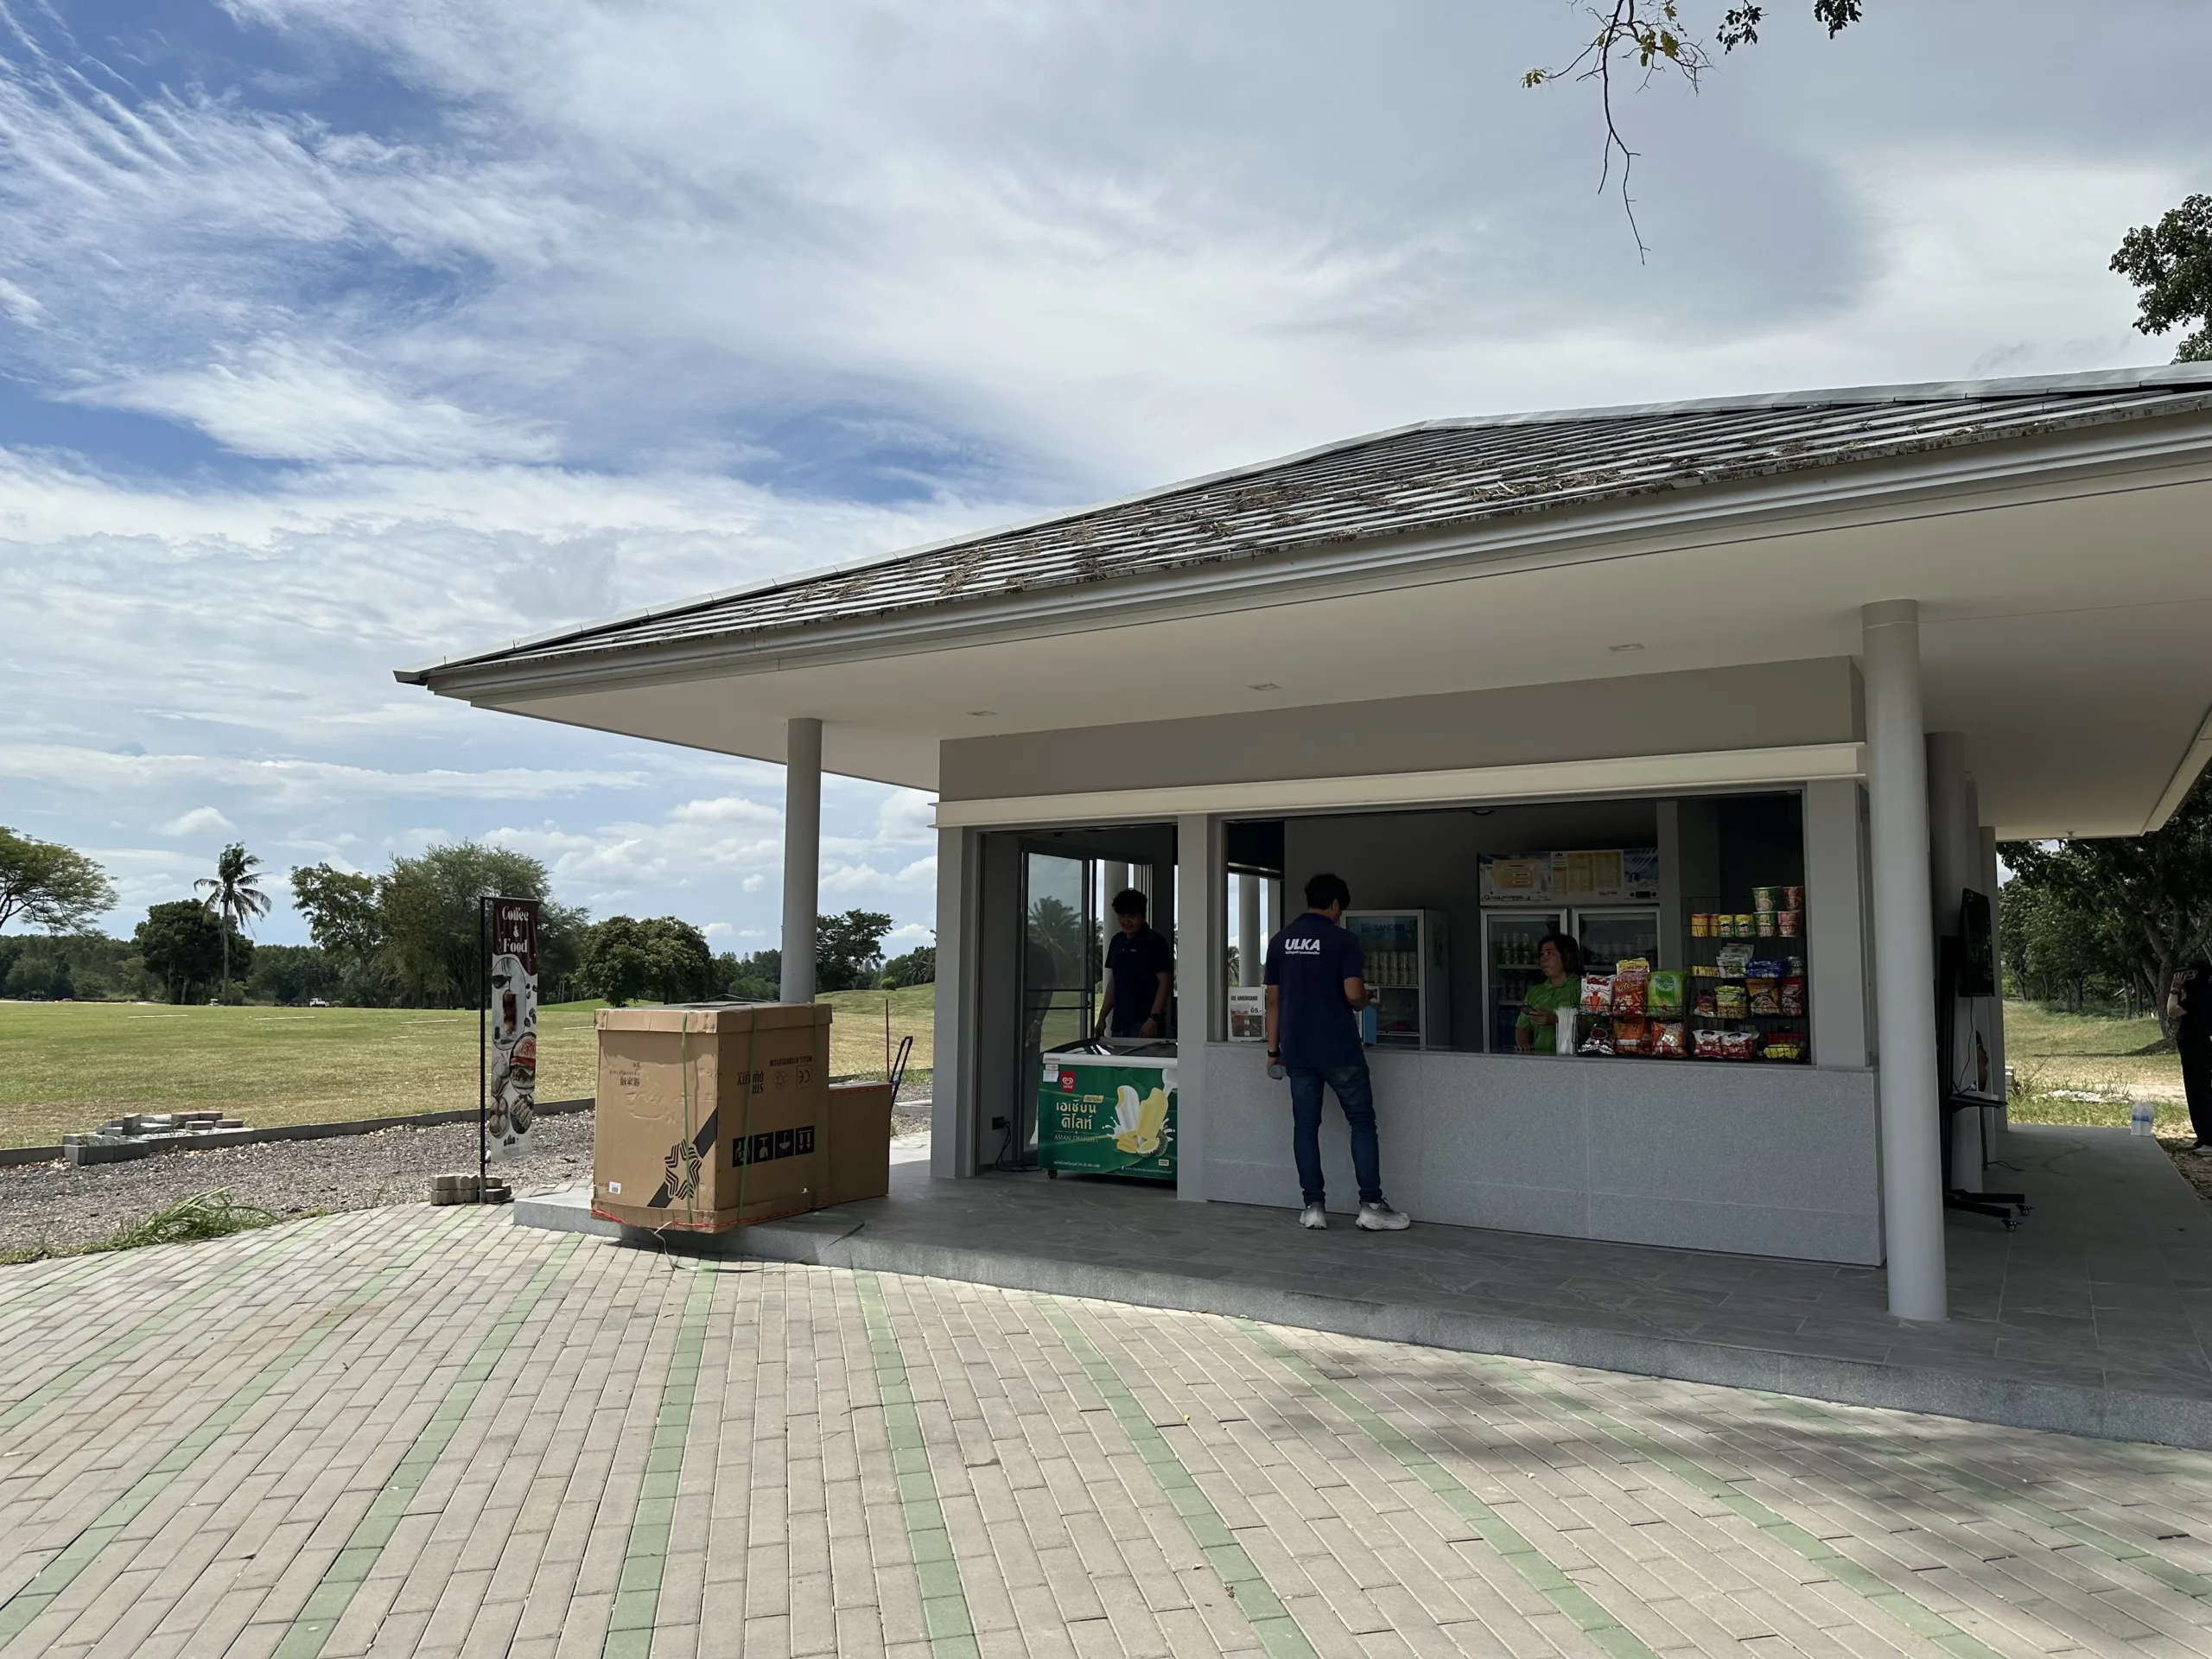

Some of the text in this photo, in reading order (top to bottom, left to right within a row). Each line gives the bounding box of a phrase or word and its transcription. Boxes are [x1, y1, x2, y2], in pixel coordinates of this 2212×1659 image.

[502, 906, 529, 921] Coffee
[513, 925, 519, 938] &
[503, 938, 528, 953] Food
[1285, 938, 1320, 950] ULKA
[1072, 1135, 1098, 1143] DELIGHT
